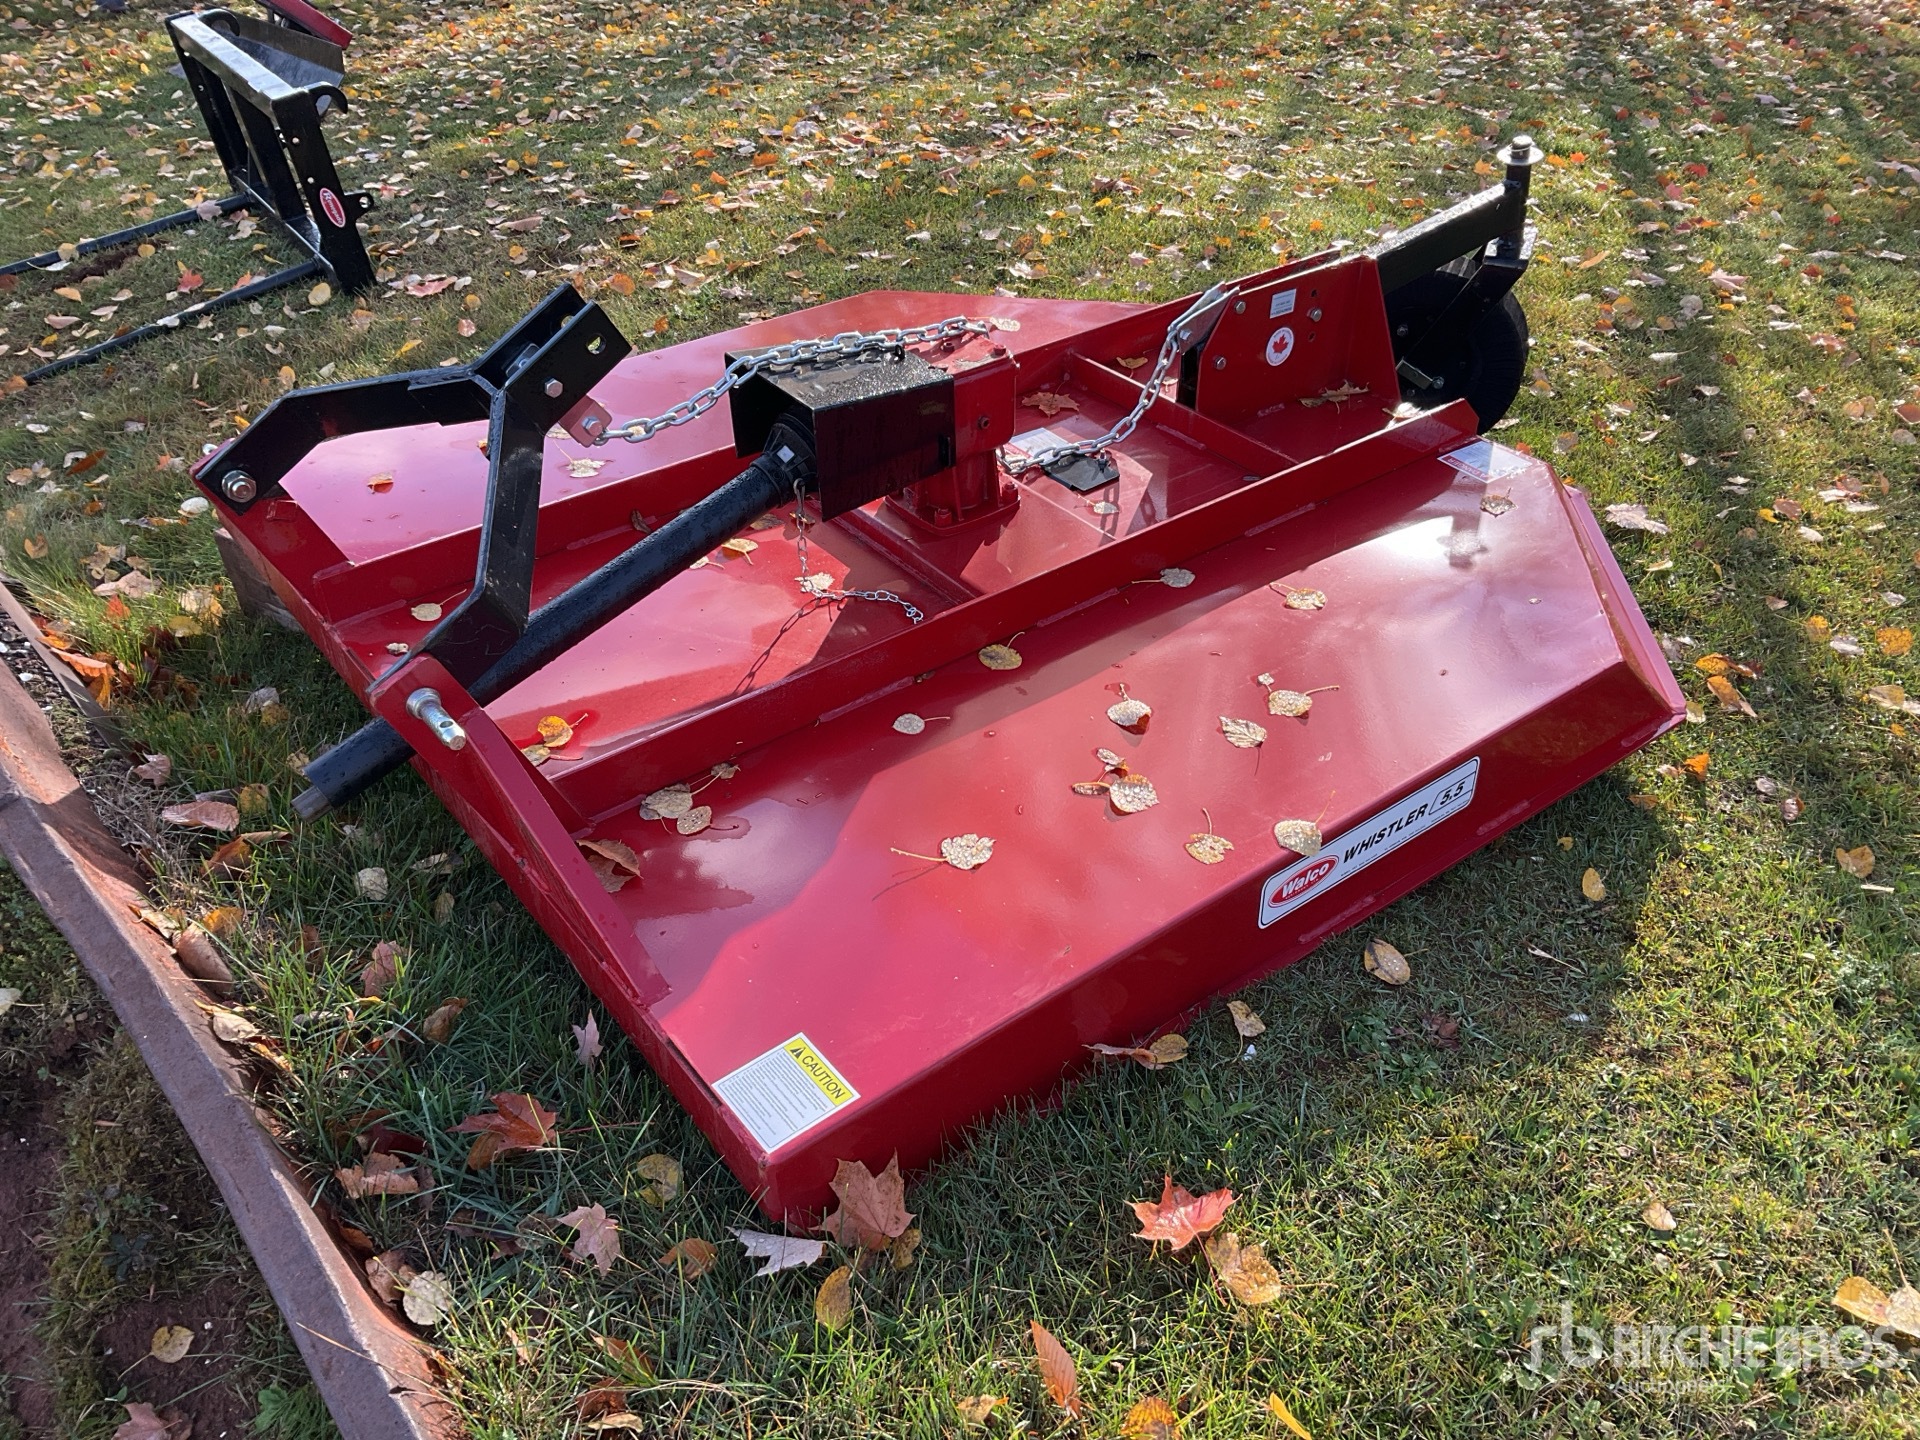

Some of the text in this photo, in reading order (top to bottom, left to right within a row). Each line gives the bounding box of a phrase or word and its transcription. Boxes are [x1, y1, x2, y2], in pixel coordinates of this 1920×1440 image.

[323, 192, 343, 225] Renegade
[1343, 803, 1429, 864] WHISTLER
[1440, 781, 1466, 806] 5.5
[1281, 862, 1330, 898] Walco
[802, 1055, 846, 1099] CAUTION
